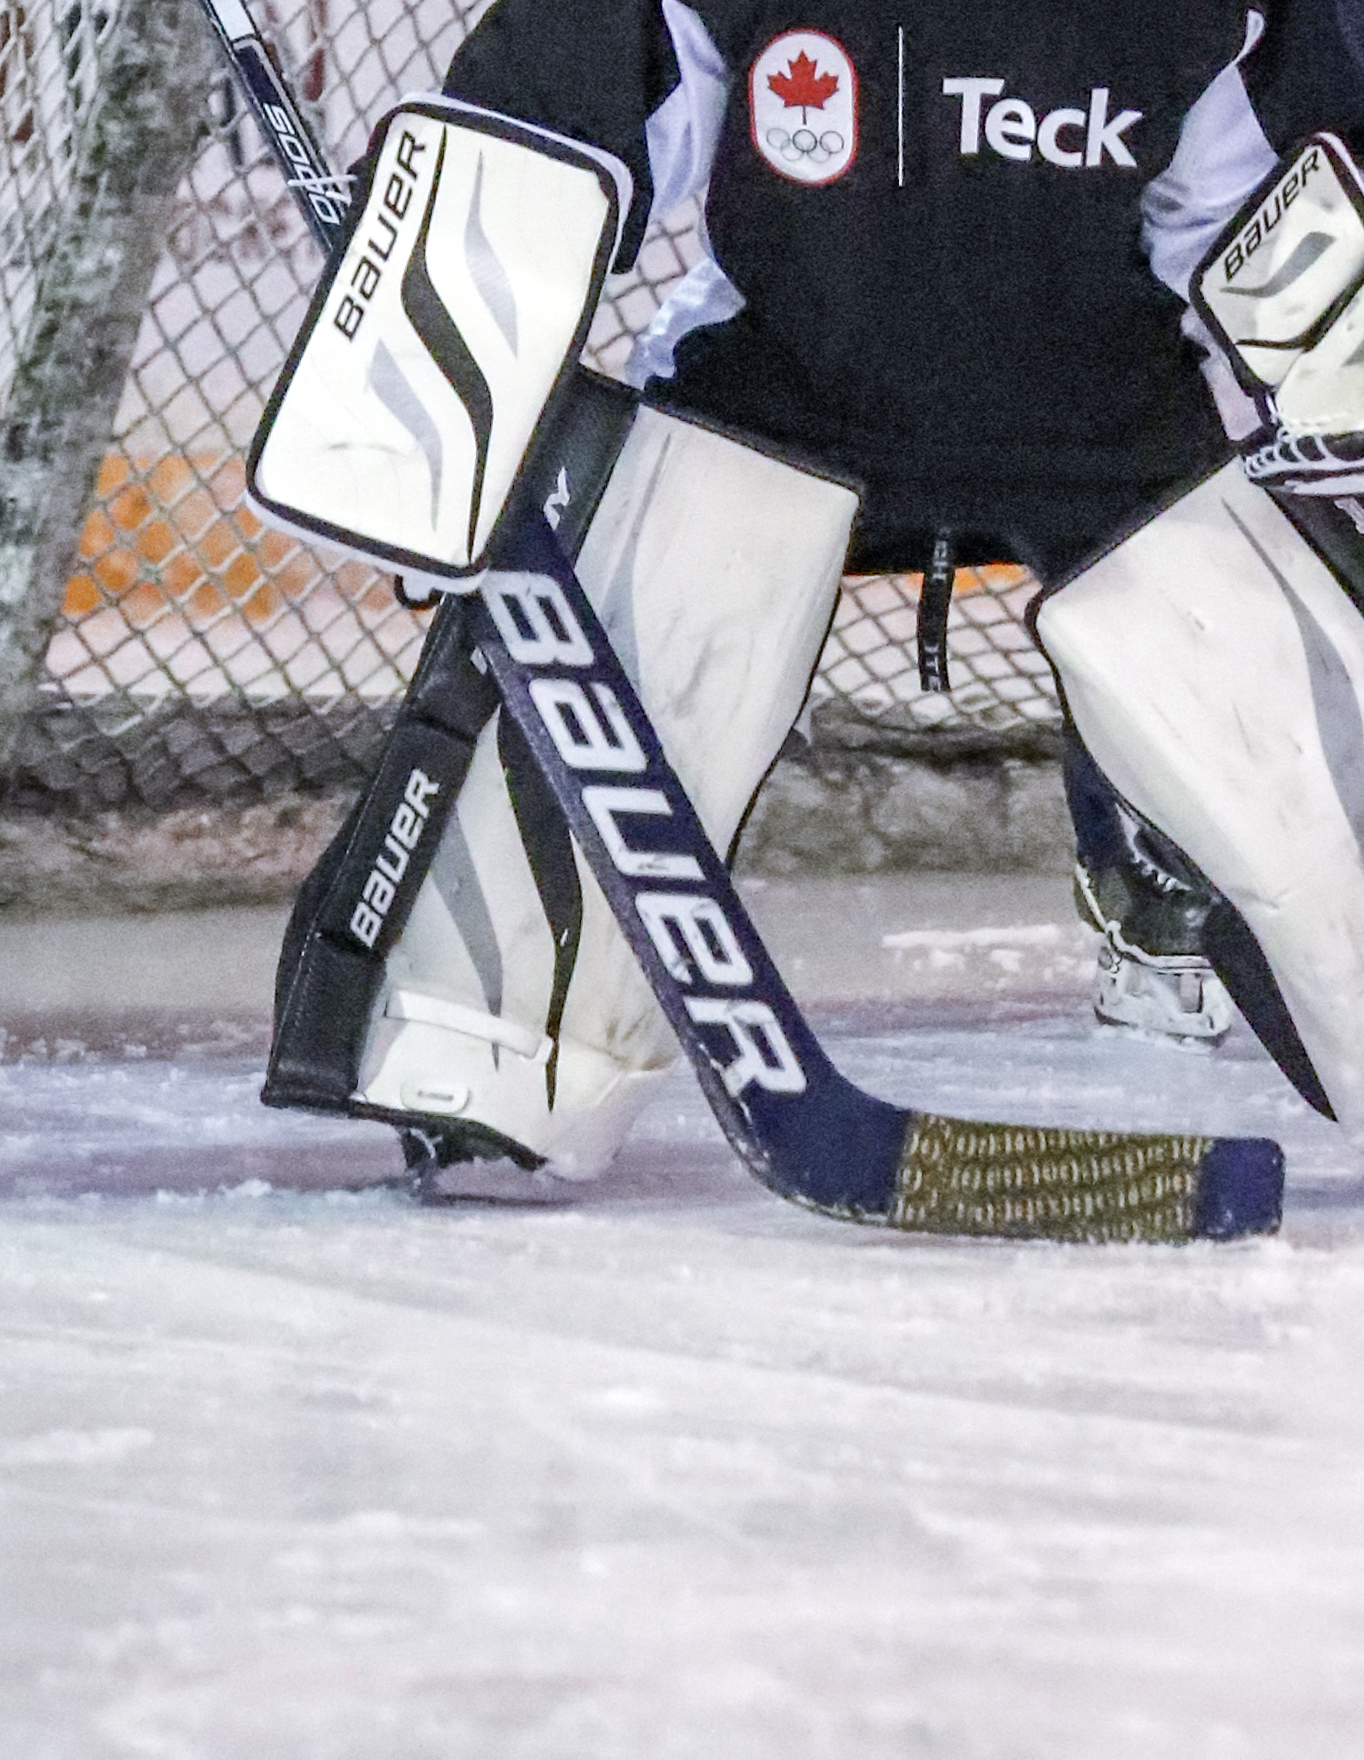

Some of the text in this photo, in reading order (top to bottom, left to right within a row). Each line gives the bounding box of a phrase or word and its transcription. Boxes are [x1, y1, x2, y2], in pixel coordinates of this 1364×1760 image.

[942, 76, 1144, 169] Teck
[334, 129, 426, 343] BAUER
[1224, 148, 1320, 283] BAUER
[350, 768, 440, 949] BAUER
[483, 569, 807, 1098] BAUER
